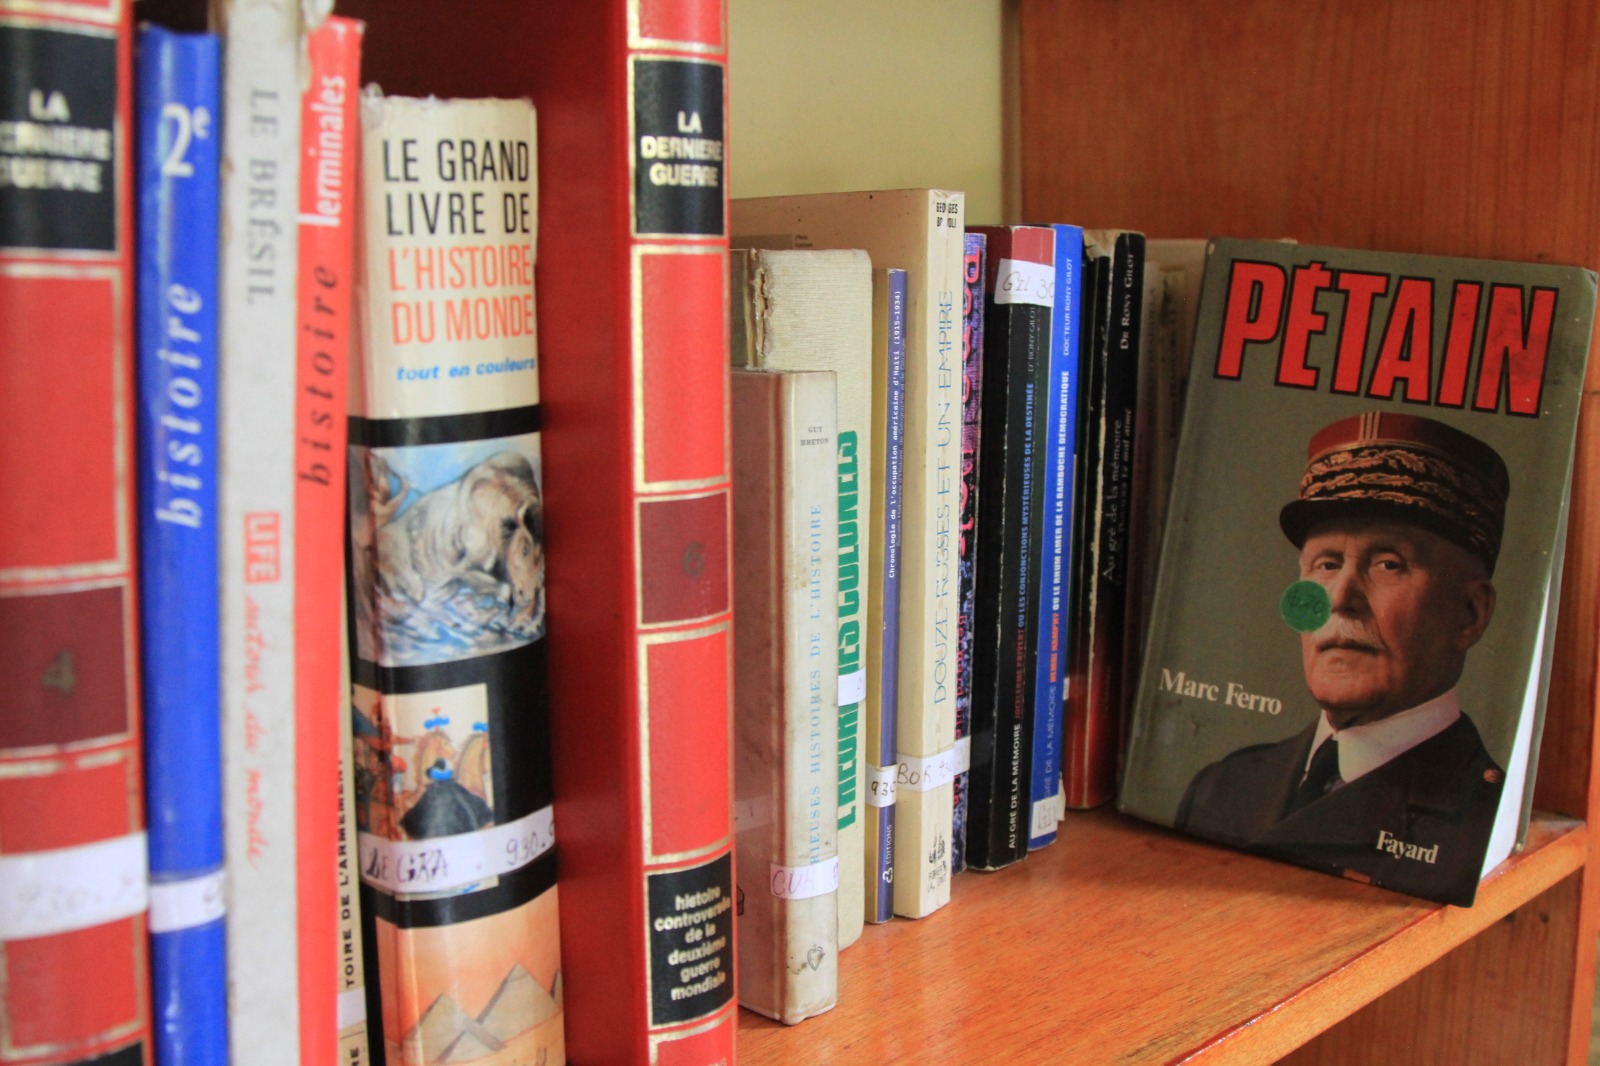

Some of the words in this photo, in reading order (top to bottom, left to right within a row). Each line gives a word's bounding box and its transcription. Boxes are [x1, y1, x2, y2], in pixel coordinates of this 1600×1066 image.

[249, 88, 279, 136] LE
[678, 111, 702, 133] LA
[383, 140, 418, 182] LE
[437, 139, 529, 182] GRAND
[650, 163, 718, 187] GUERRE
[386, 193, 485, 235] LIVRE
[503, 192, 530, 233] DE
[388, 244, 532, 291] L'HISTOIRE
[1065, 258, 1073, 285] GILOT
[1063, 286, 1072, 311] RONY
[391, 301, 435, 344] DU
[445, 295, 534, 342] MONDE
[893, 290, 901, 345] (1915-1934)
[1063, 312, 1071, 356] DOCTEUR
[938, 290, 952, 389] EMPIRE
[1214, 258, 1560, 418] PÉTAIN
[300, 265, 336, 486] histoire
[397, 366, 440, 380] tout
[449, 364, 470, 377] en
[476, 357, 535, 375] couleurs
[155, 284, 202, 529] histoire
[890, 390, 899, 441] américaine
[1025, 383, 1034, 428] DESTINÉE
[937, 402, 951, 448] UN
[1024, 429, 1031, 441] LA
[1023, 442, 1031, 455] DE
[1110, 420, 1121, 482] mémoire
[890, 445, 899, 505] l'occupation
[937, 458, 951, 495] ET
[1057, 446, 1066, 499] BAMBOCHE
[1022, 457, 1030, 525] MYSTÉRIEUSES
[1056, 501, 1064, 512] LA
[1106, 486, 1119, 500] la
[889, 509, 896, 520] de
[1055, 513, 1063, 526] DE
[1106, 503, 1118, 522] de
[246, 514, 279, 581] LIFE
[888, 523, 896, 579] Chronologie
[936, 504, 950, 597] RUSSES
[1054, 527, 1063, 554] AMER
[1108, 527, 1118, 552] gré
[682, 541, 704, 577] 6
[810, 505, 821, 619] L'HISTOIRE
[1019, 526, 1028, 596] CONJONCTIONS
[1053, 555, 1062, 584] RHUM
[1102, 555, 1117, 580] Au
[1052, 597, 1060, 611] OU
[1053, 585, 1061, 596] LE
[1018, 614, 1025, 628] OU
[1051, 613, 1059, 652] NAMPHY
[810, 633, 820, 657] DE
[934, 608, 948, 704] DOUZE
[1159, 667, 1220, 702] Marc
[1223, 681, 1283, 716] Ferro
[810, 670, 821, 774] HISTOIRES
[1011, 723, 1021, 776] MÉMOIRE
[1045, 758, 1053, 773] DE
[1046, 741, 1053, 756] LA
[1010, 795, 1018, 809] DE
[1011, 779, 1018, 793] LA
[810, 785, 821, 864] RIEUSES
[1008, 834, 1016, 849] AU
[1376, 830, 1439, 864] Fayard
[341, 894, 351, 920] DE
[675, 886, 721, 911] histoire
[685, 927, 703, 943] de
[705, 923, 716, 937] la
[671, 971, 726, 1001] mondiale
[680, 957, 720, 983] guerre
